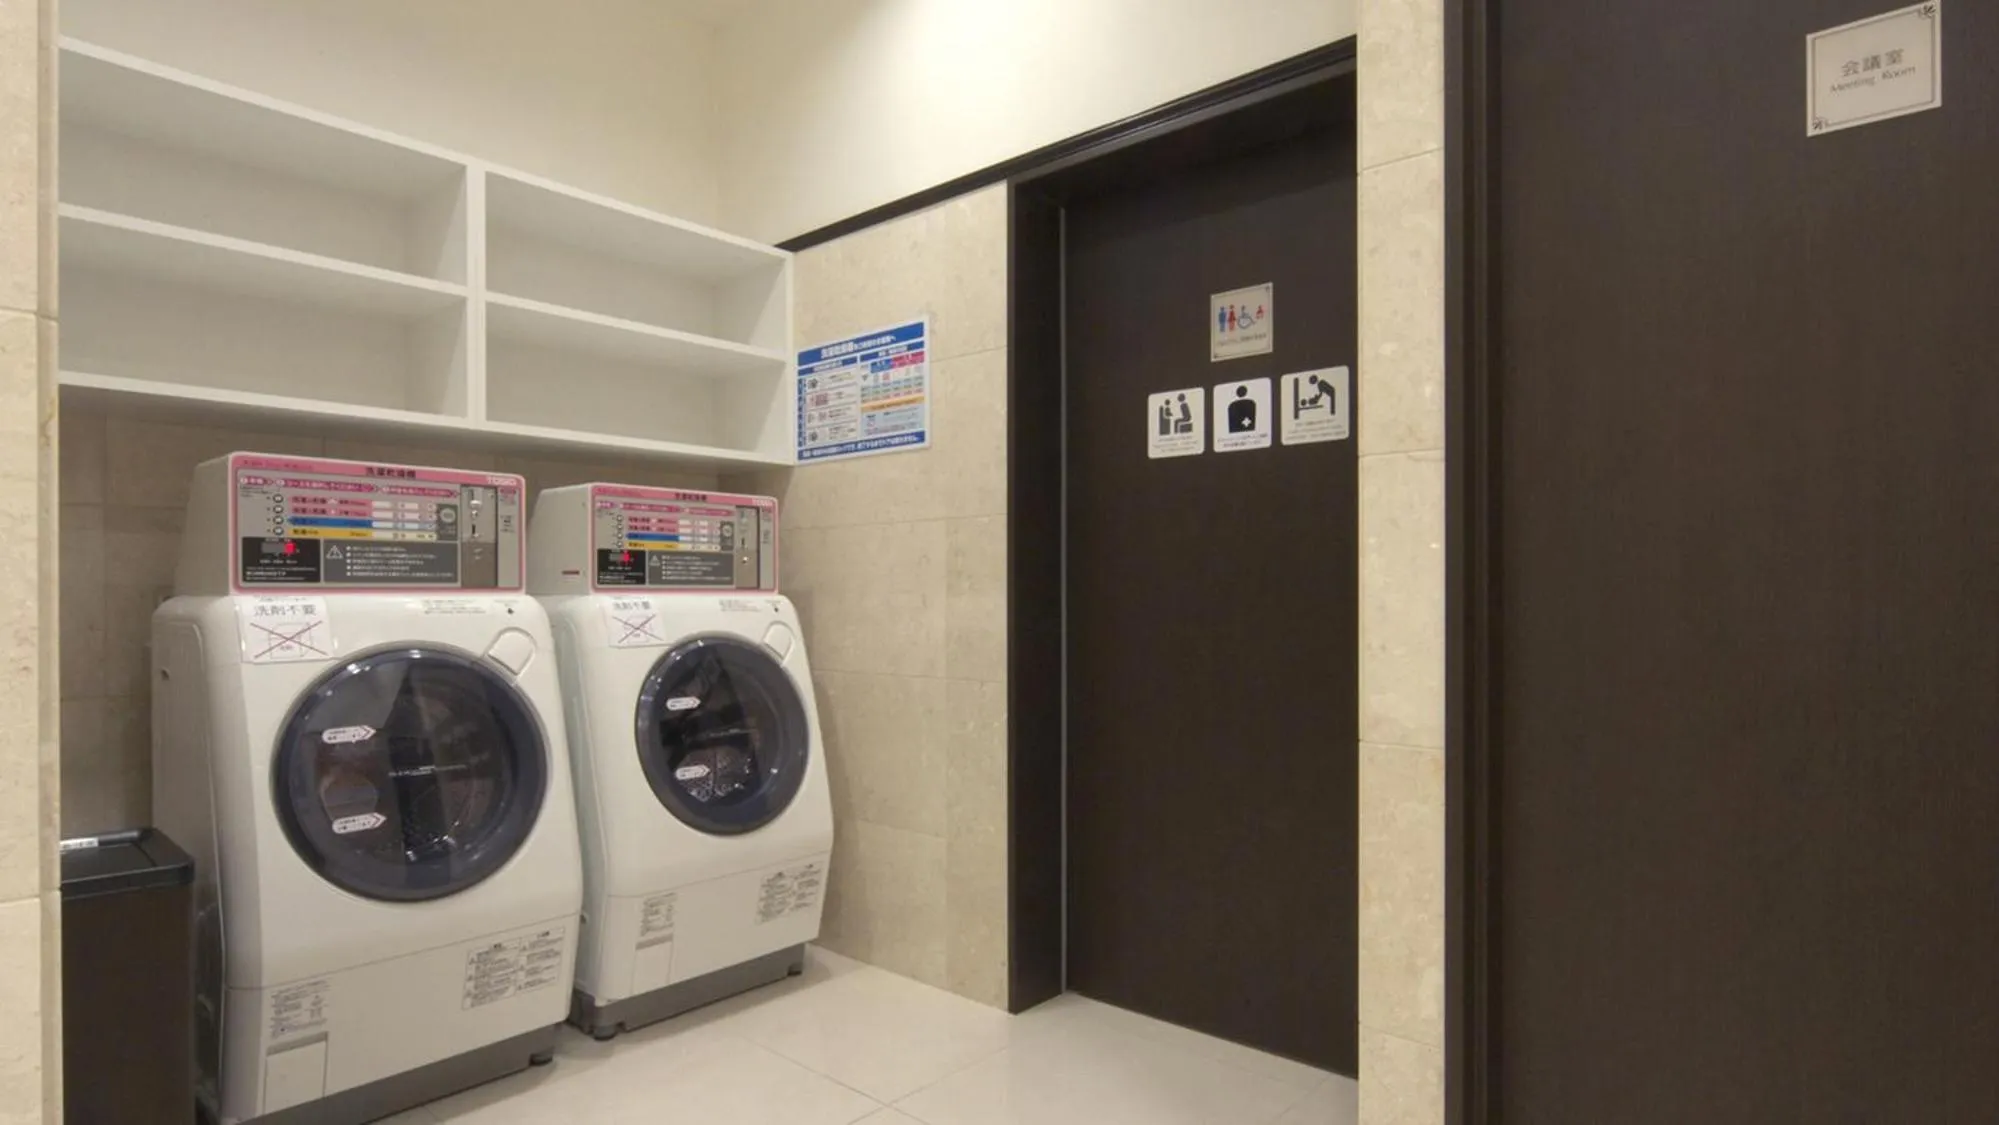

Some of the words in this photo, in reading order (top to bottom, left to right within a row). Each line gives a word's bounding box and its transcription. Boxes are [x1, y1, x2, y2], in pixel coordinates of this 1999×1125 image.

[1841, 48, 1905, 77] 会議室
[1830, 76, 1876, 95] Meeting
[1881, 66, 1916, 81] Room
[253, 603, 317, 618] 洗剤不要
